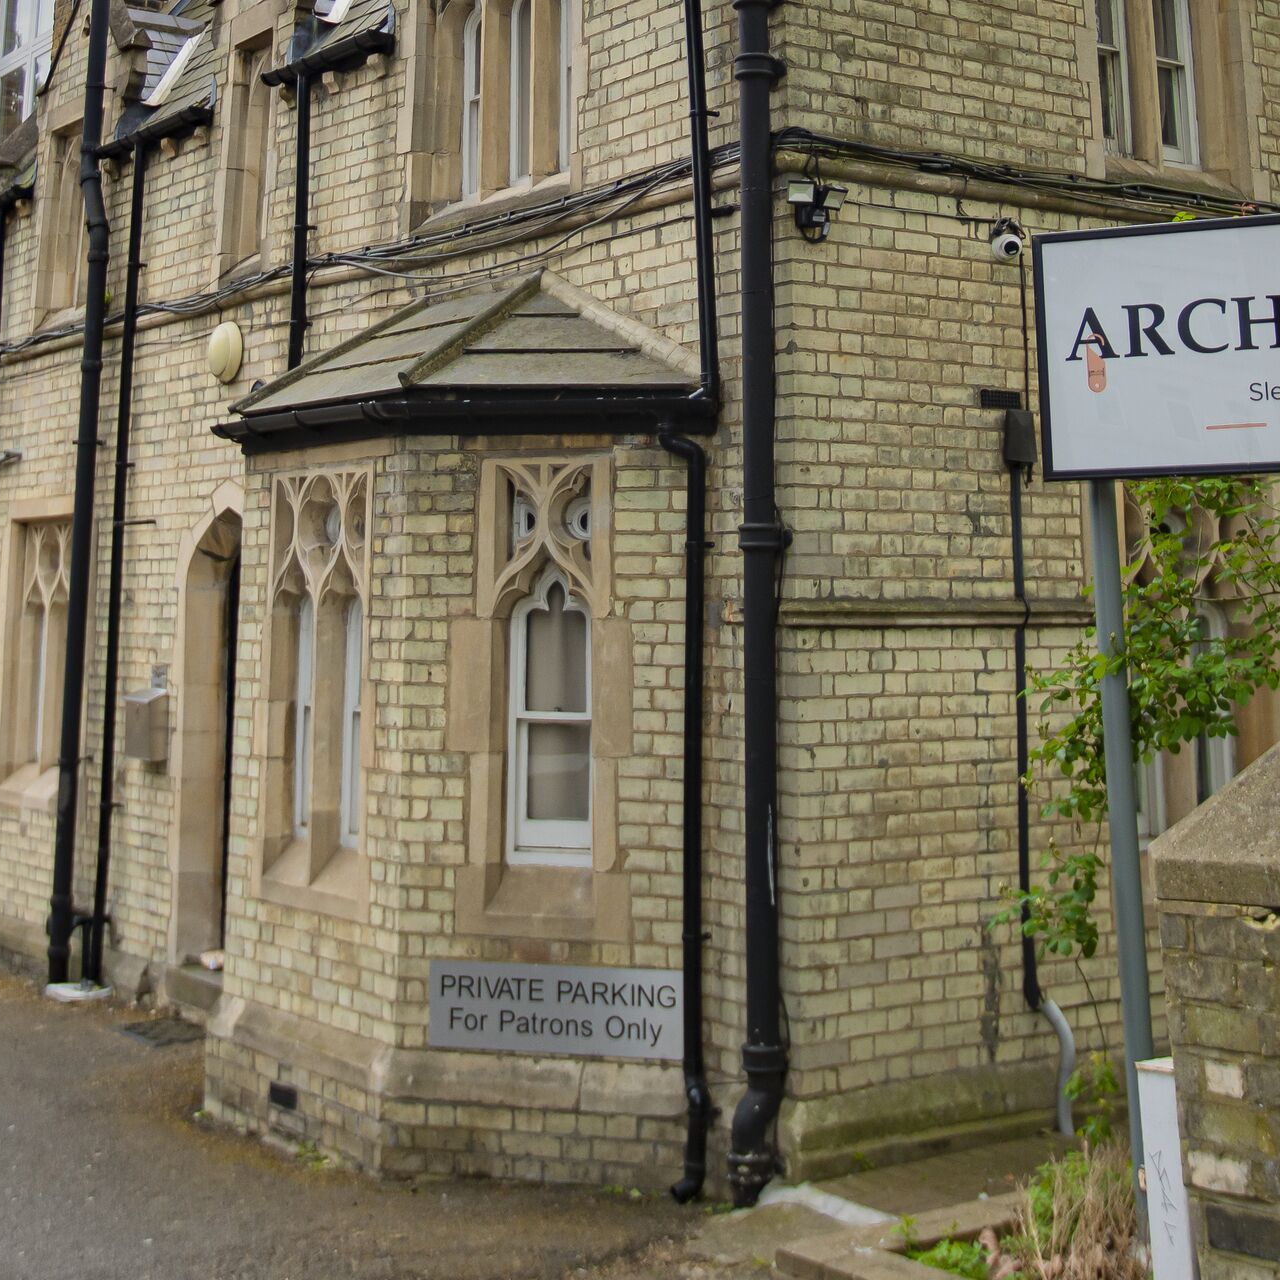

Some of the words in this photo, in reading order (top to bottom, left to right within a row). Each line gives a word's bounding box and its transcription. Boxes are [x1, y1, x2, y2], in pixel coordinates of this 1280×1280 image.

[440, 974, 545, 1002] PRIVATE
[555, 978, 677, 1009] PARKING
[449, 1006, 489, 1032] For
[499, 1009, 594, 1038] Patrons
[605, 1014, 663, 1048] Only
